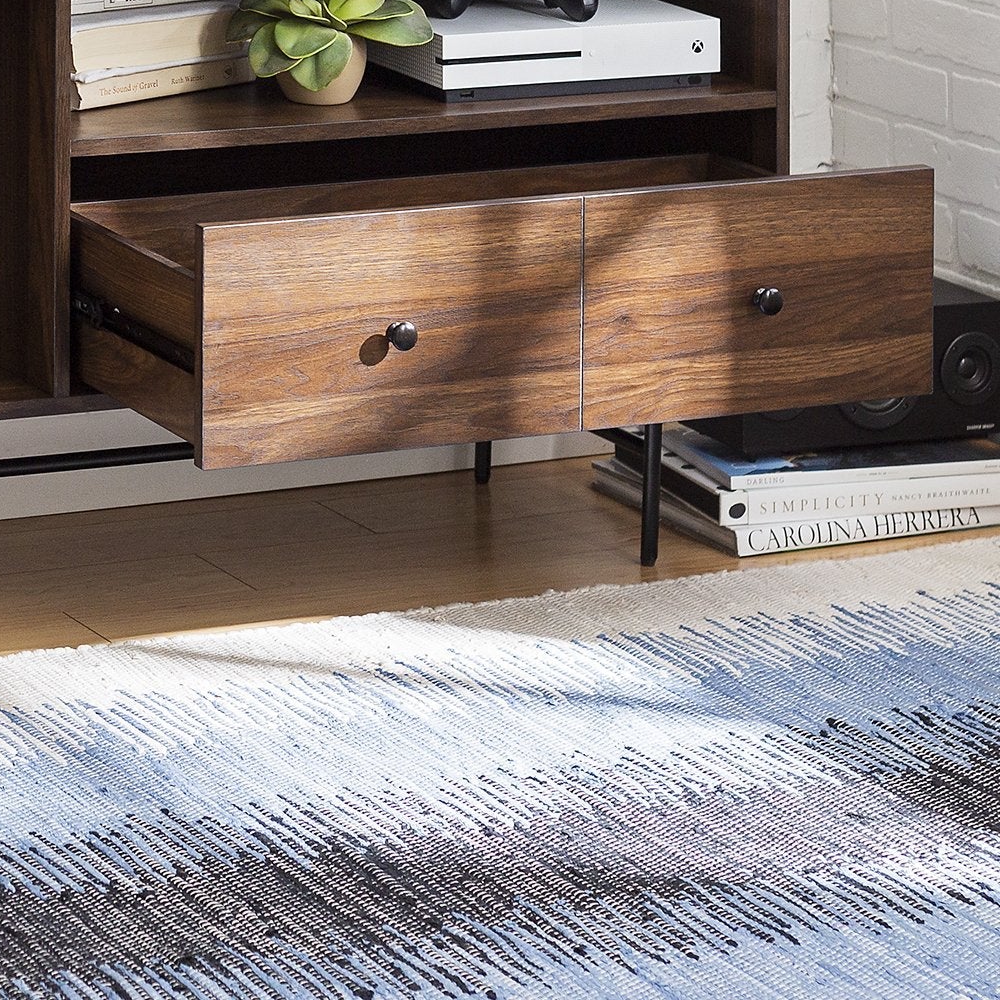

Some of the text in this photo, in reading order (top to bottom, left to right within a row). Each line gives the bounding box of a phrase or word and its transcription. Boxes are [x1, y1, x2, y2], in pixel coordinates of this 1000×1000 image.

[99, 79, 159, 97] The Sound of Gravel
[746, 476, 786, 486] DARLING
[759, 492, 884, 515] SIMPLICITY
[891, 494, 922, 502] NANCY
[748, 506, 981, 552] CAROLINA HERRERA
